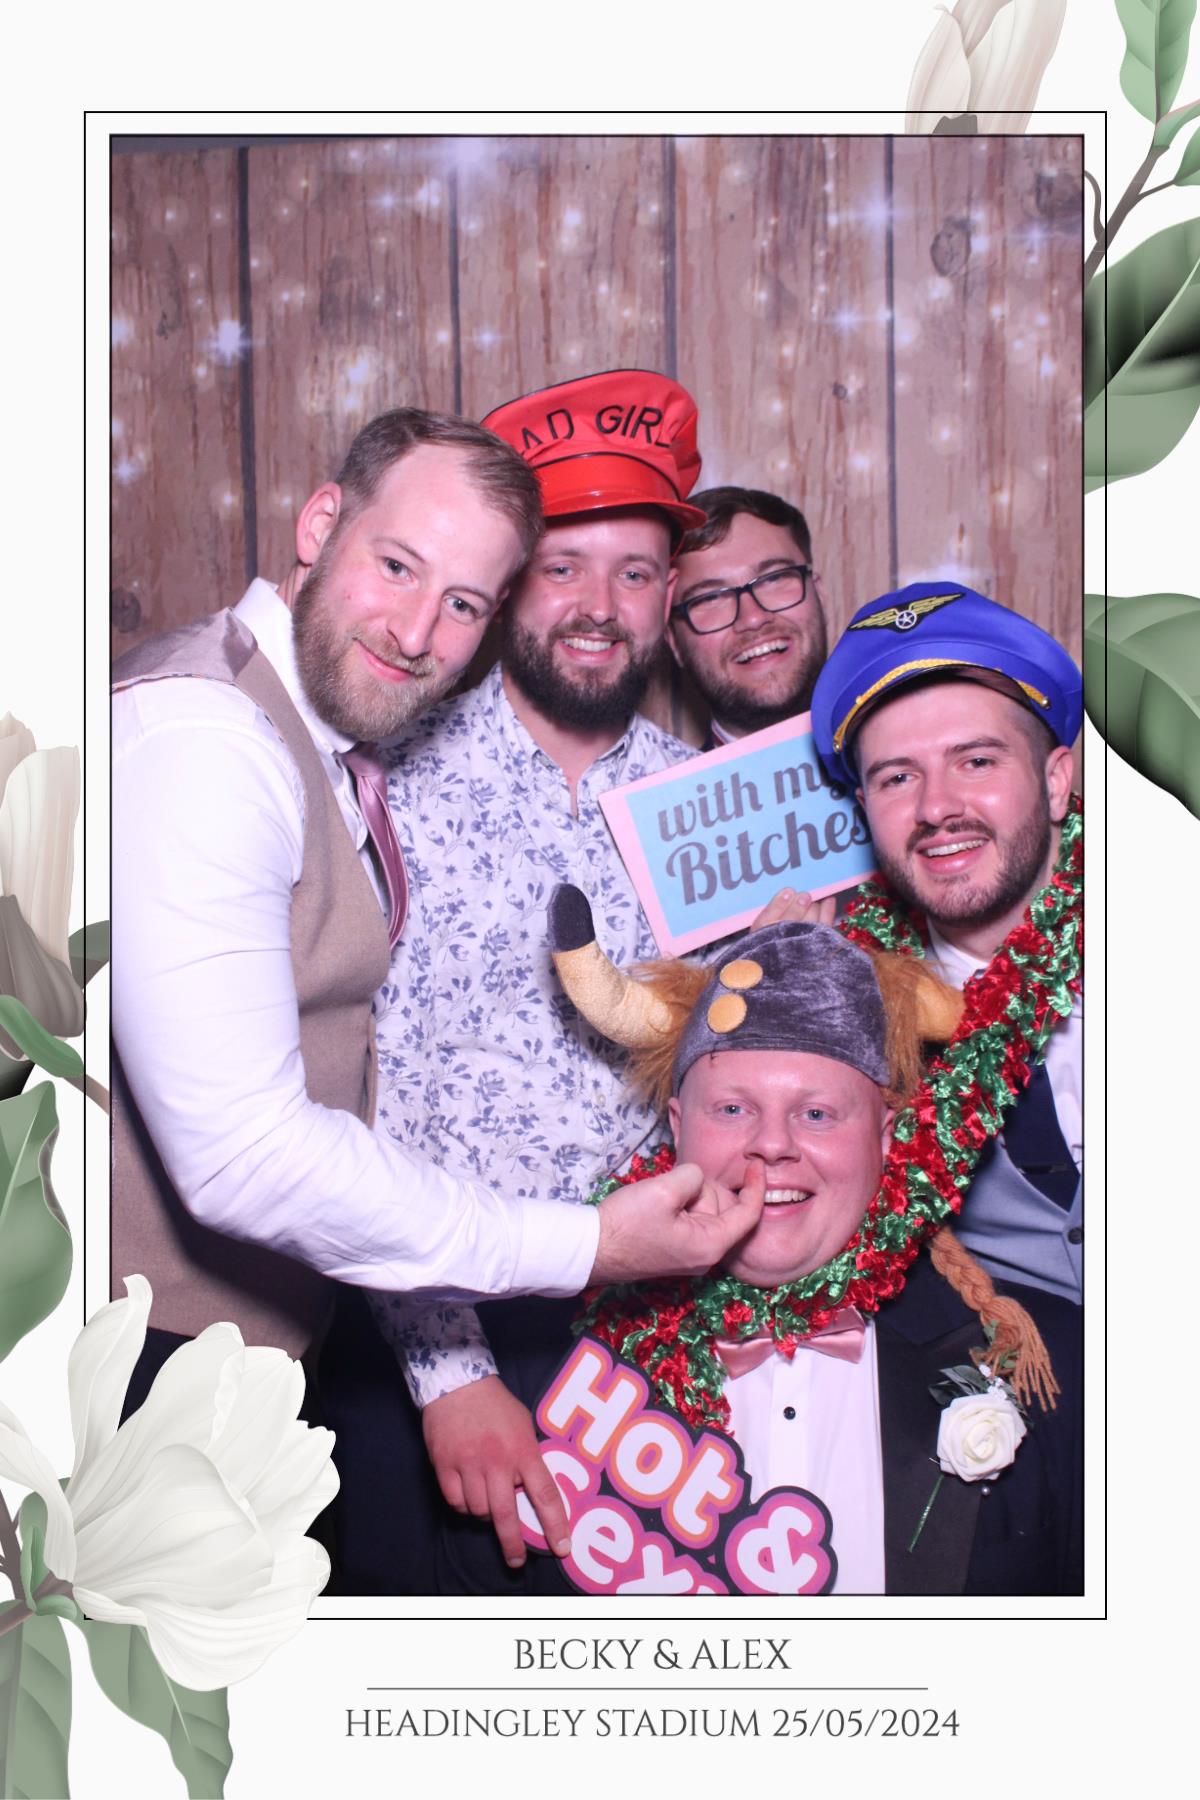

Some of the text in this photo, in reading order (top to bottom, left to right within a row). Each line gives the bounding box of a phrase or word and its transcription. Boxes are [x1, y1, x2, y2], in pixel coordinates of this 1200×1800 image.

[520, 407, 574, 455] AD
[656, 762, 842, 842] with m
[665, 810, 873, 906] Bitches
[544, 1347, 819, 1594] Hot &
[514, 1449, 717, 1595] Sex
